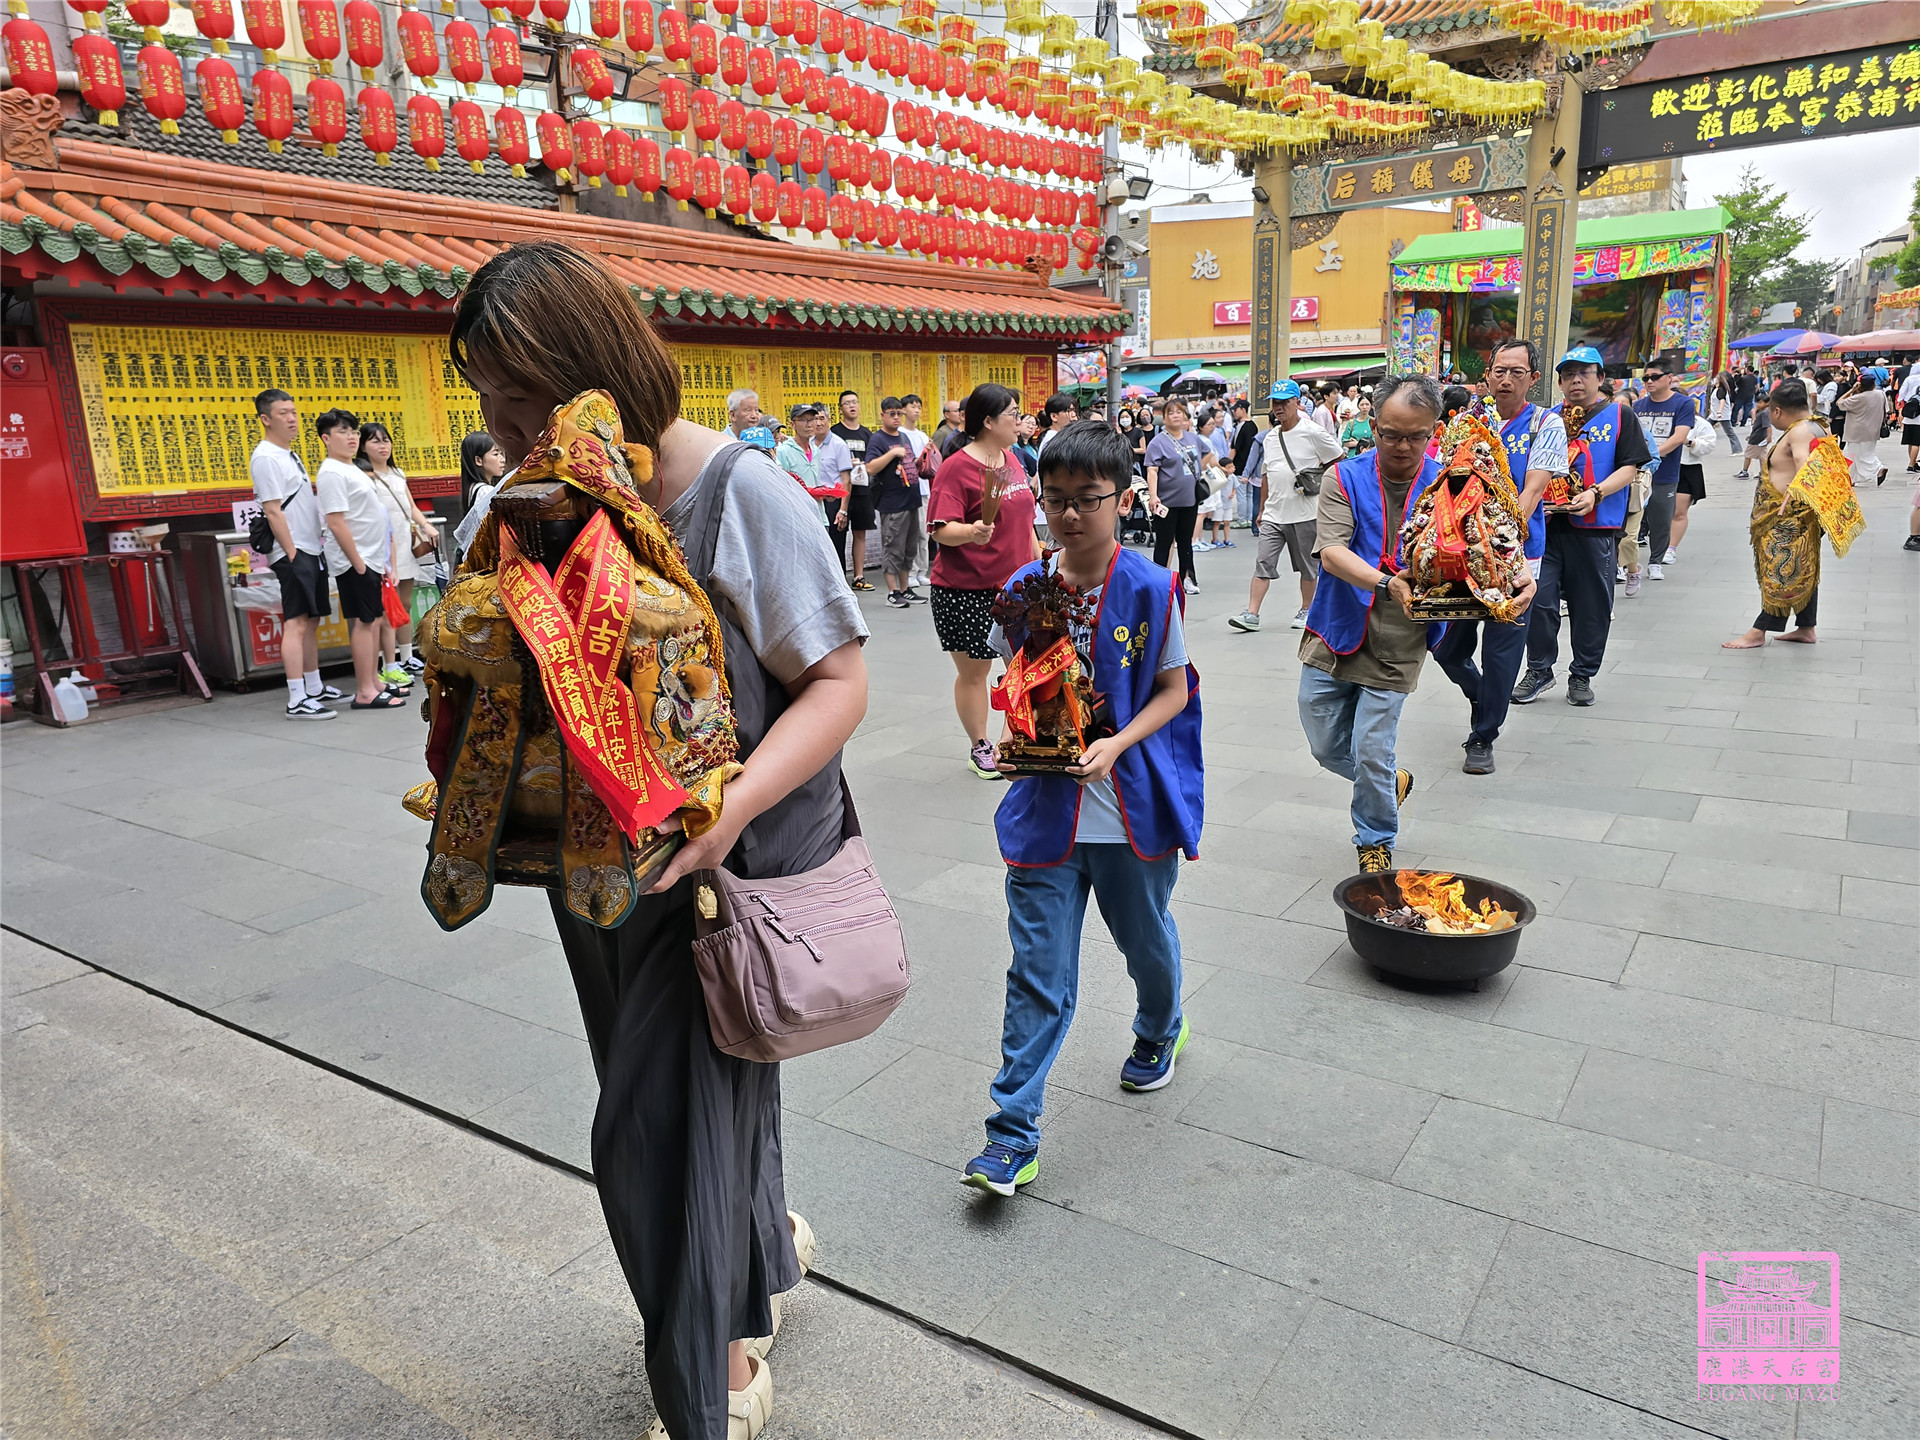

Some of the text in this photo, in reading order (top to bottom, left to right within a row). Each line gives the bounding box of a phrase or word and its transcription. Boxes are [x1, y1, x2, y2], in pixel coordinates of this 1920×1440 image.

[1650, 50, 1920, 119] 歡迎彰化縣和美鎮
[1596, 180, 1656, 197] 04-758-9501
